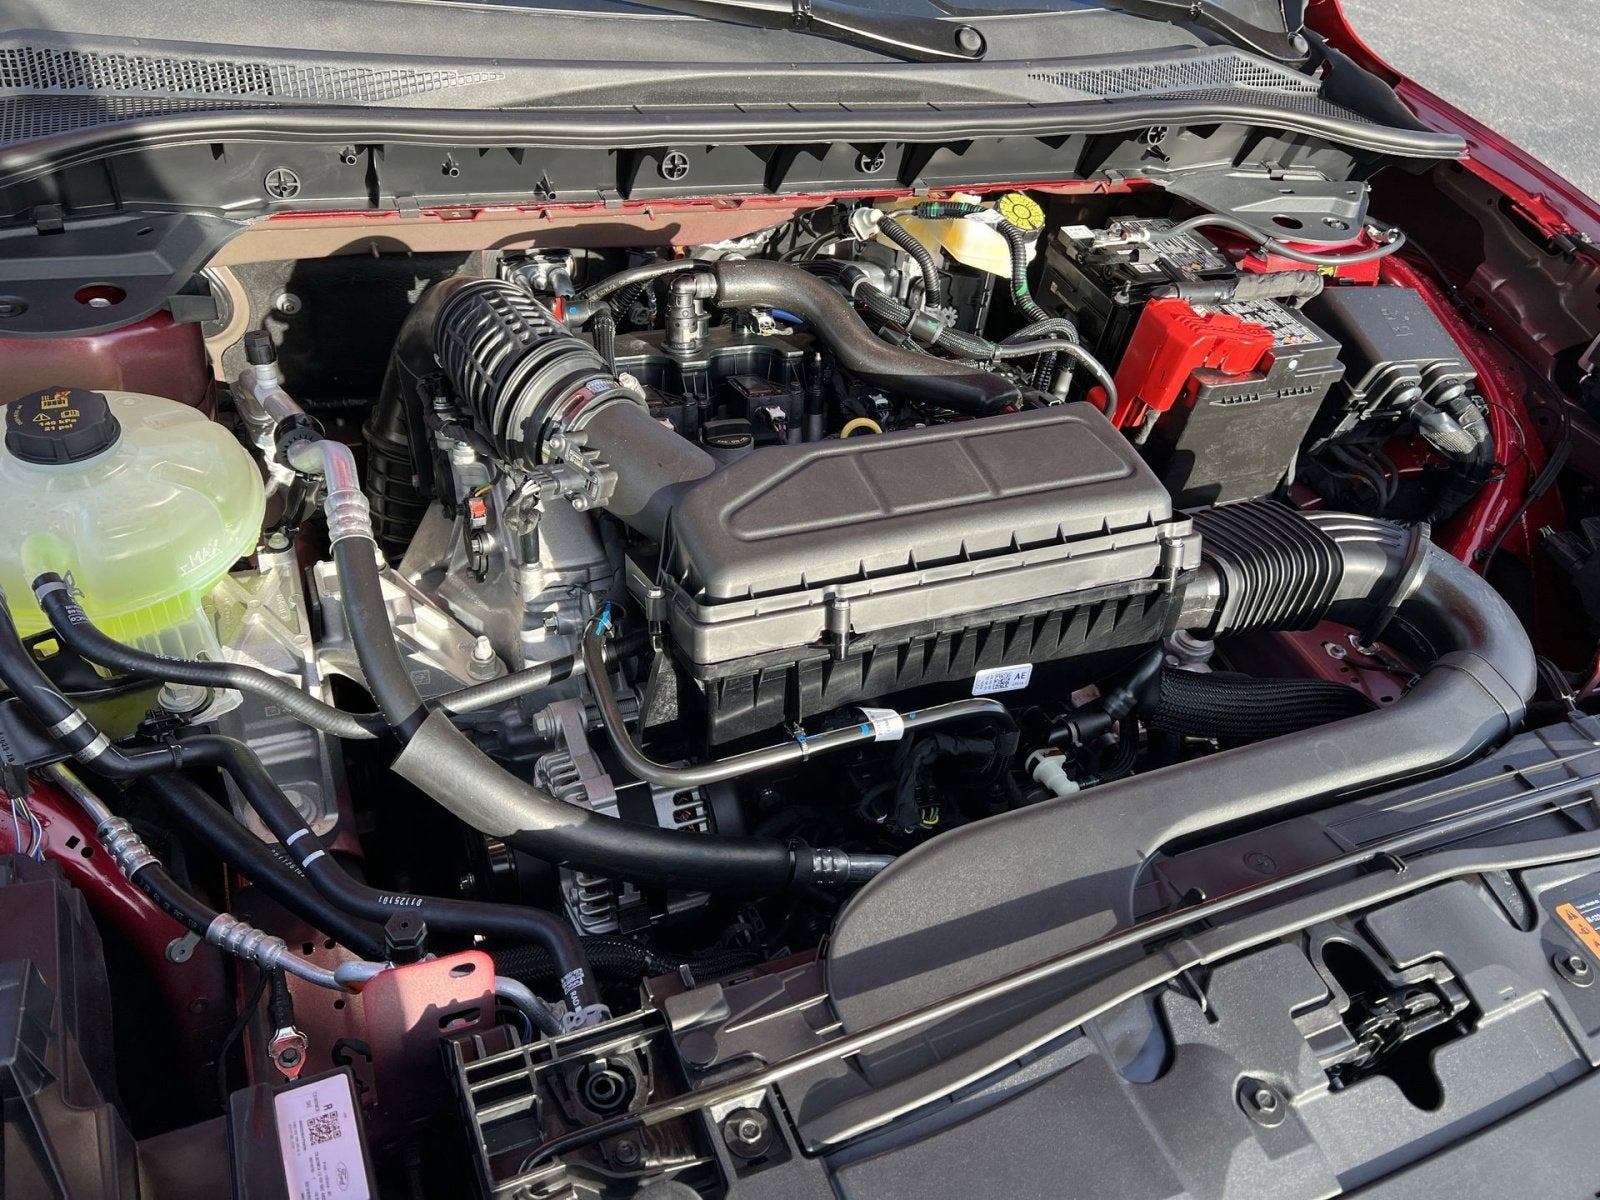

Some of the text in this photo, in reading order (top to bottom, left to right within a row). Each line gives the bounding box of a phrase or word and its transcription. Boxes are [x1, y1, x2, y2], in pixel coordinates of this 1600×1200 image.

[1014, 672, 1027, 680] AE
[569, 990, 580, 1006] RAD
[323, 1103, 333, 1111] R
